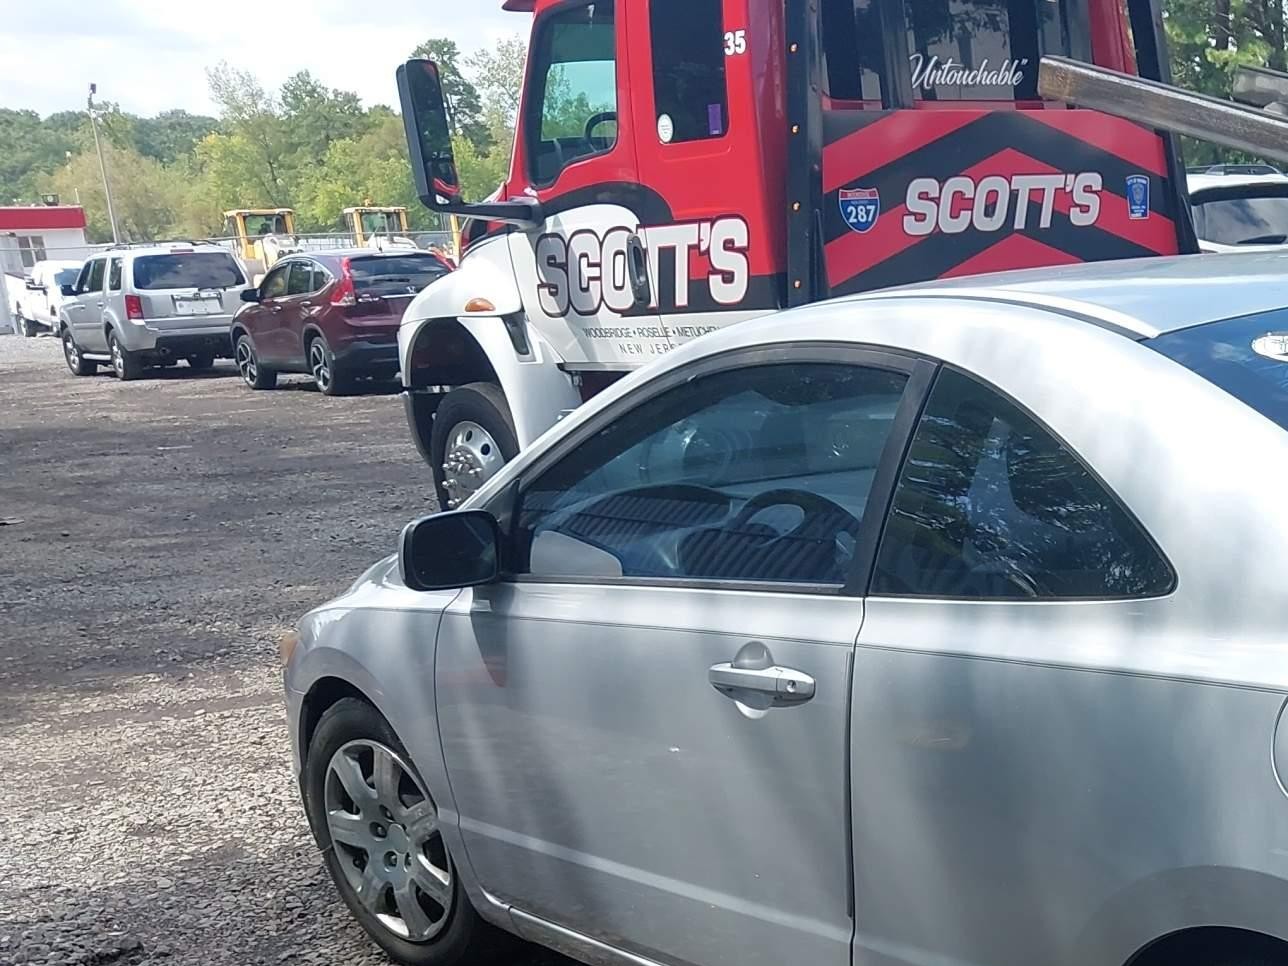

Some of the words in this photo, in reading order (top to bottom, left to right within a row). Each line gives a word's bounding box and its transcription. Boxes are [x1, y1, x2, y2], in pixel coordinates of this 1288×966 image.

[723, 29, 747, 56] 35
[847, 204, 876, 223] 287
[902, 171, 1104, 237] SCOTT'S
[536, 213, 750, 318] SCOTT'S
[676, 325, 721, 338] METUCHE
[619, 343, 643, 354] NEW
[649, 343, 684, 354] JERS
